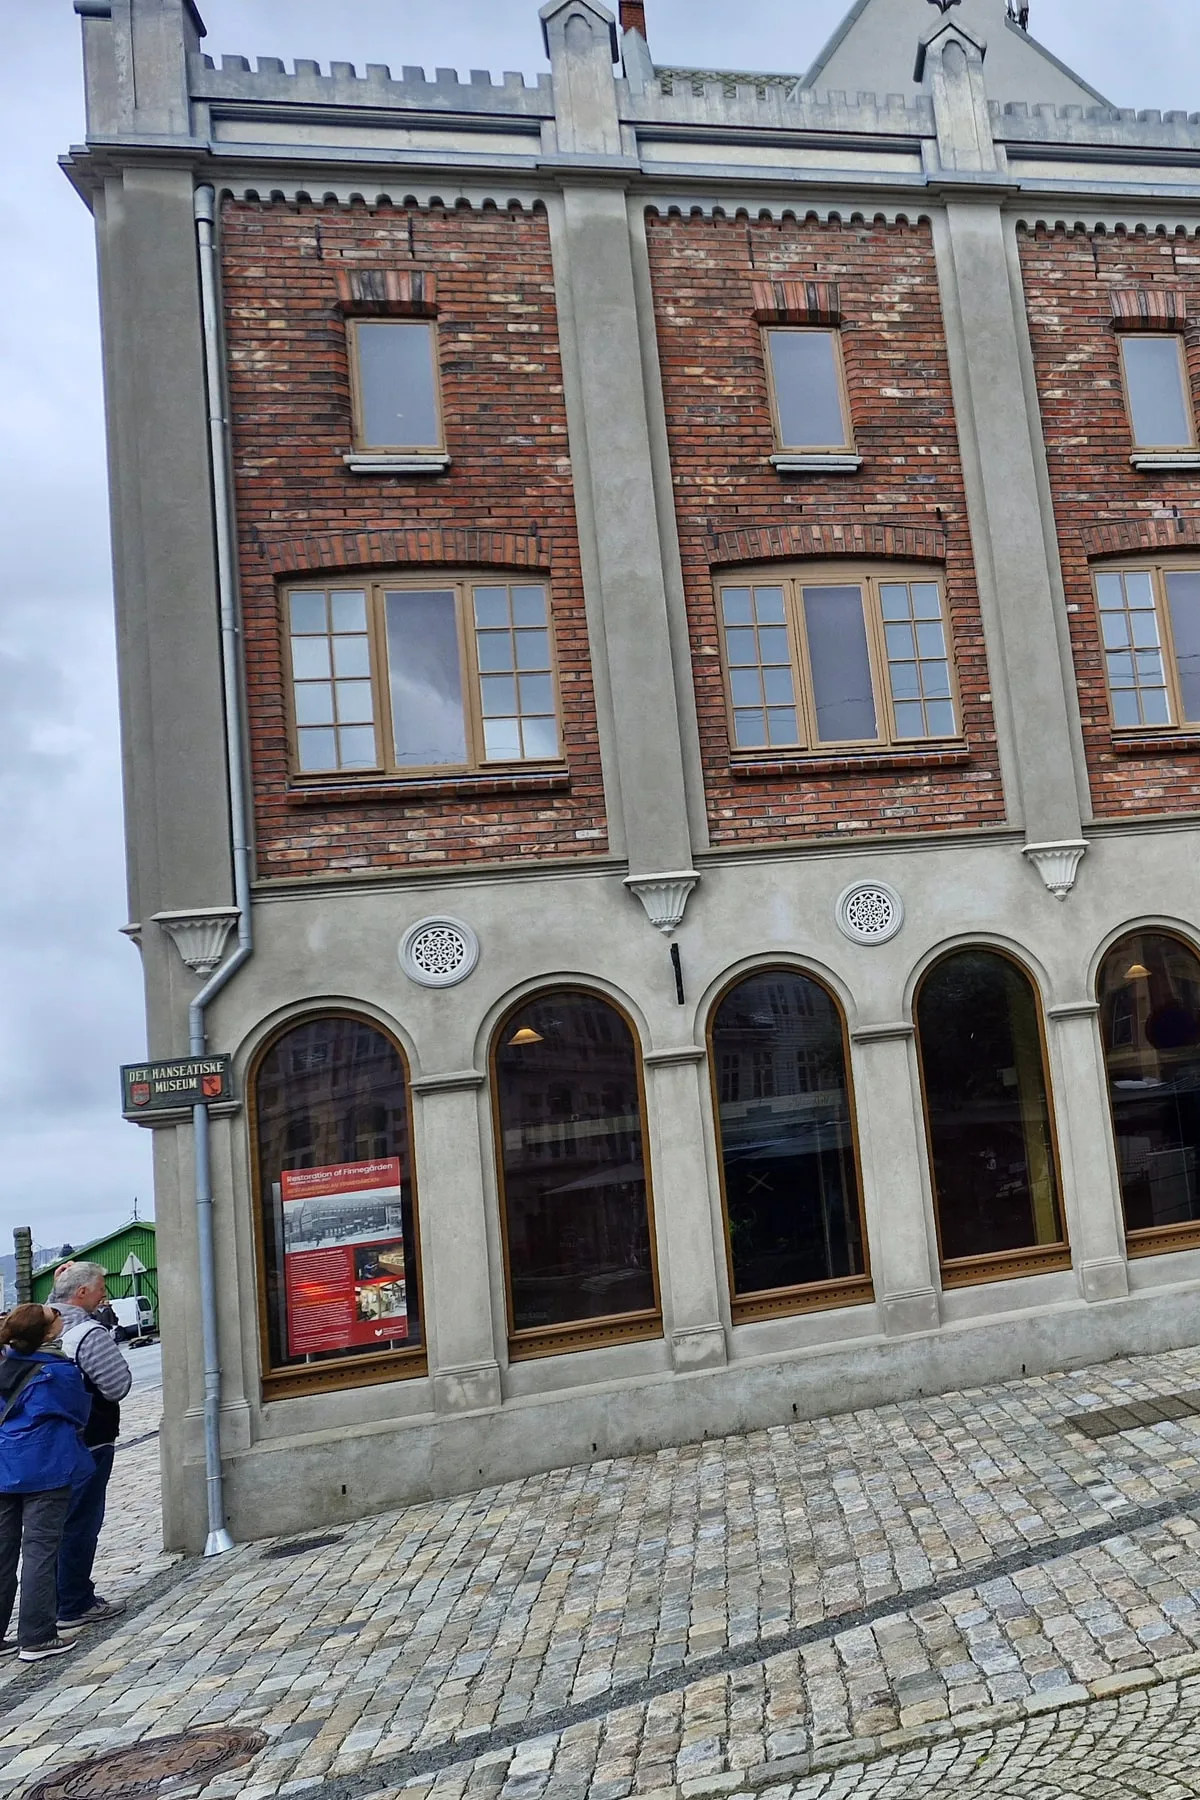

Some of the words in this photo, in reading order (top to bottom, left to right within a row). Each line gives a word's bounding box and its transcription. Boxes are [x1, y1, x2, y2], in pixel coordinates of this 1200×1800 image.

[129, 1069, 148, 1082] DET
[152, 1061, 225, 1080] HANSEATISKE
[155, 1078, 198, 1093] MUSEUM
[286, 1172, 333, 1183] Restoration
[334, 1169, 342, 1177] of
[343, 1163, 393, 1176] Finnegården
